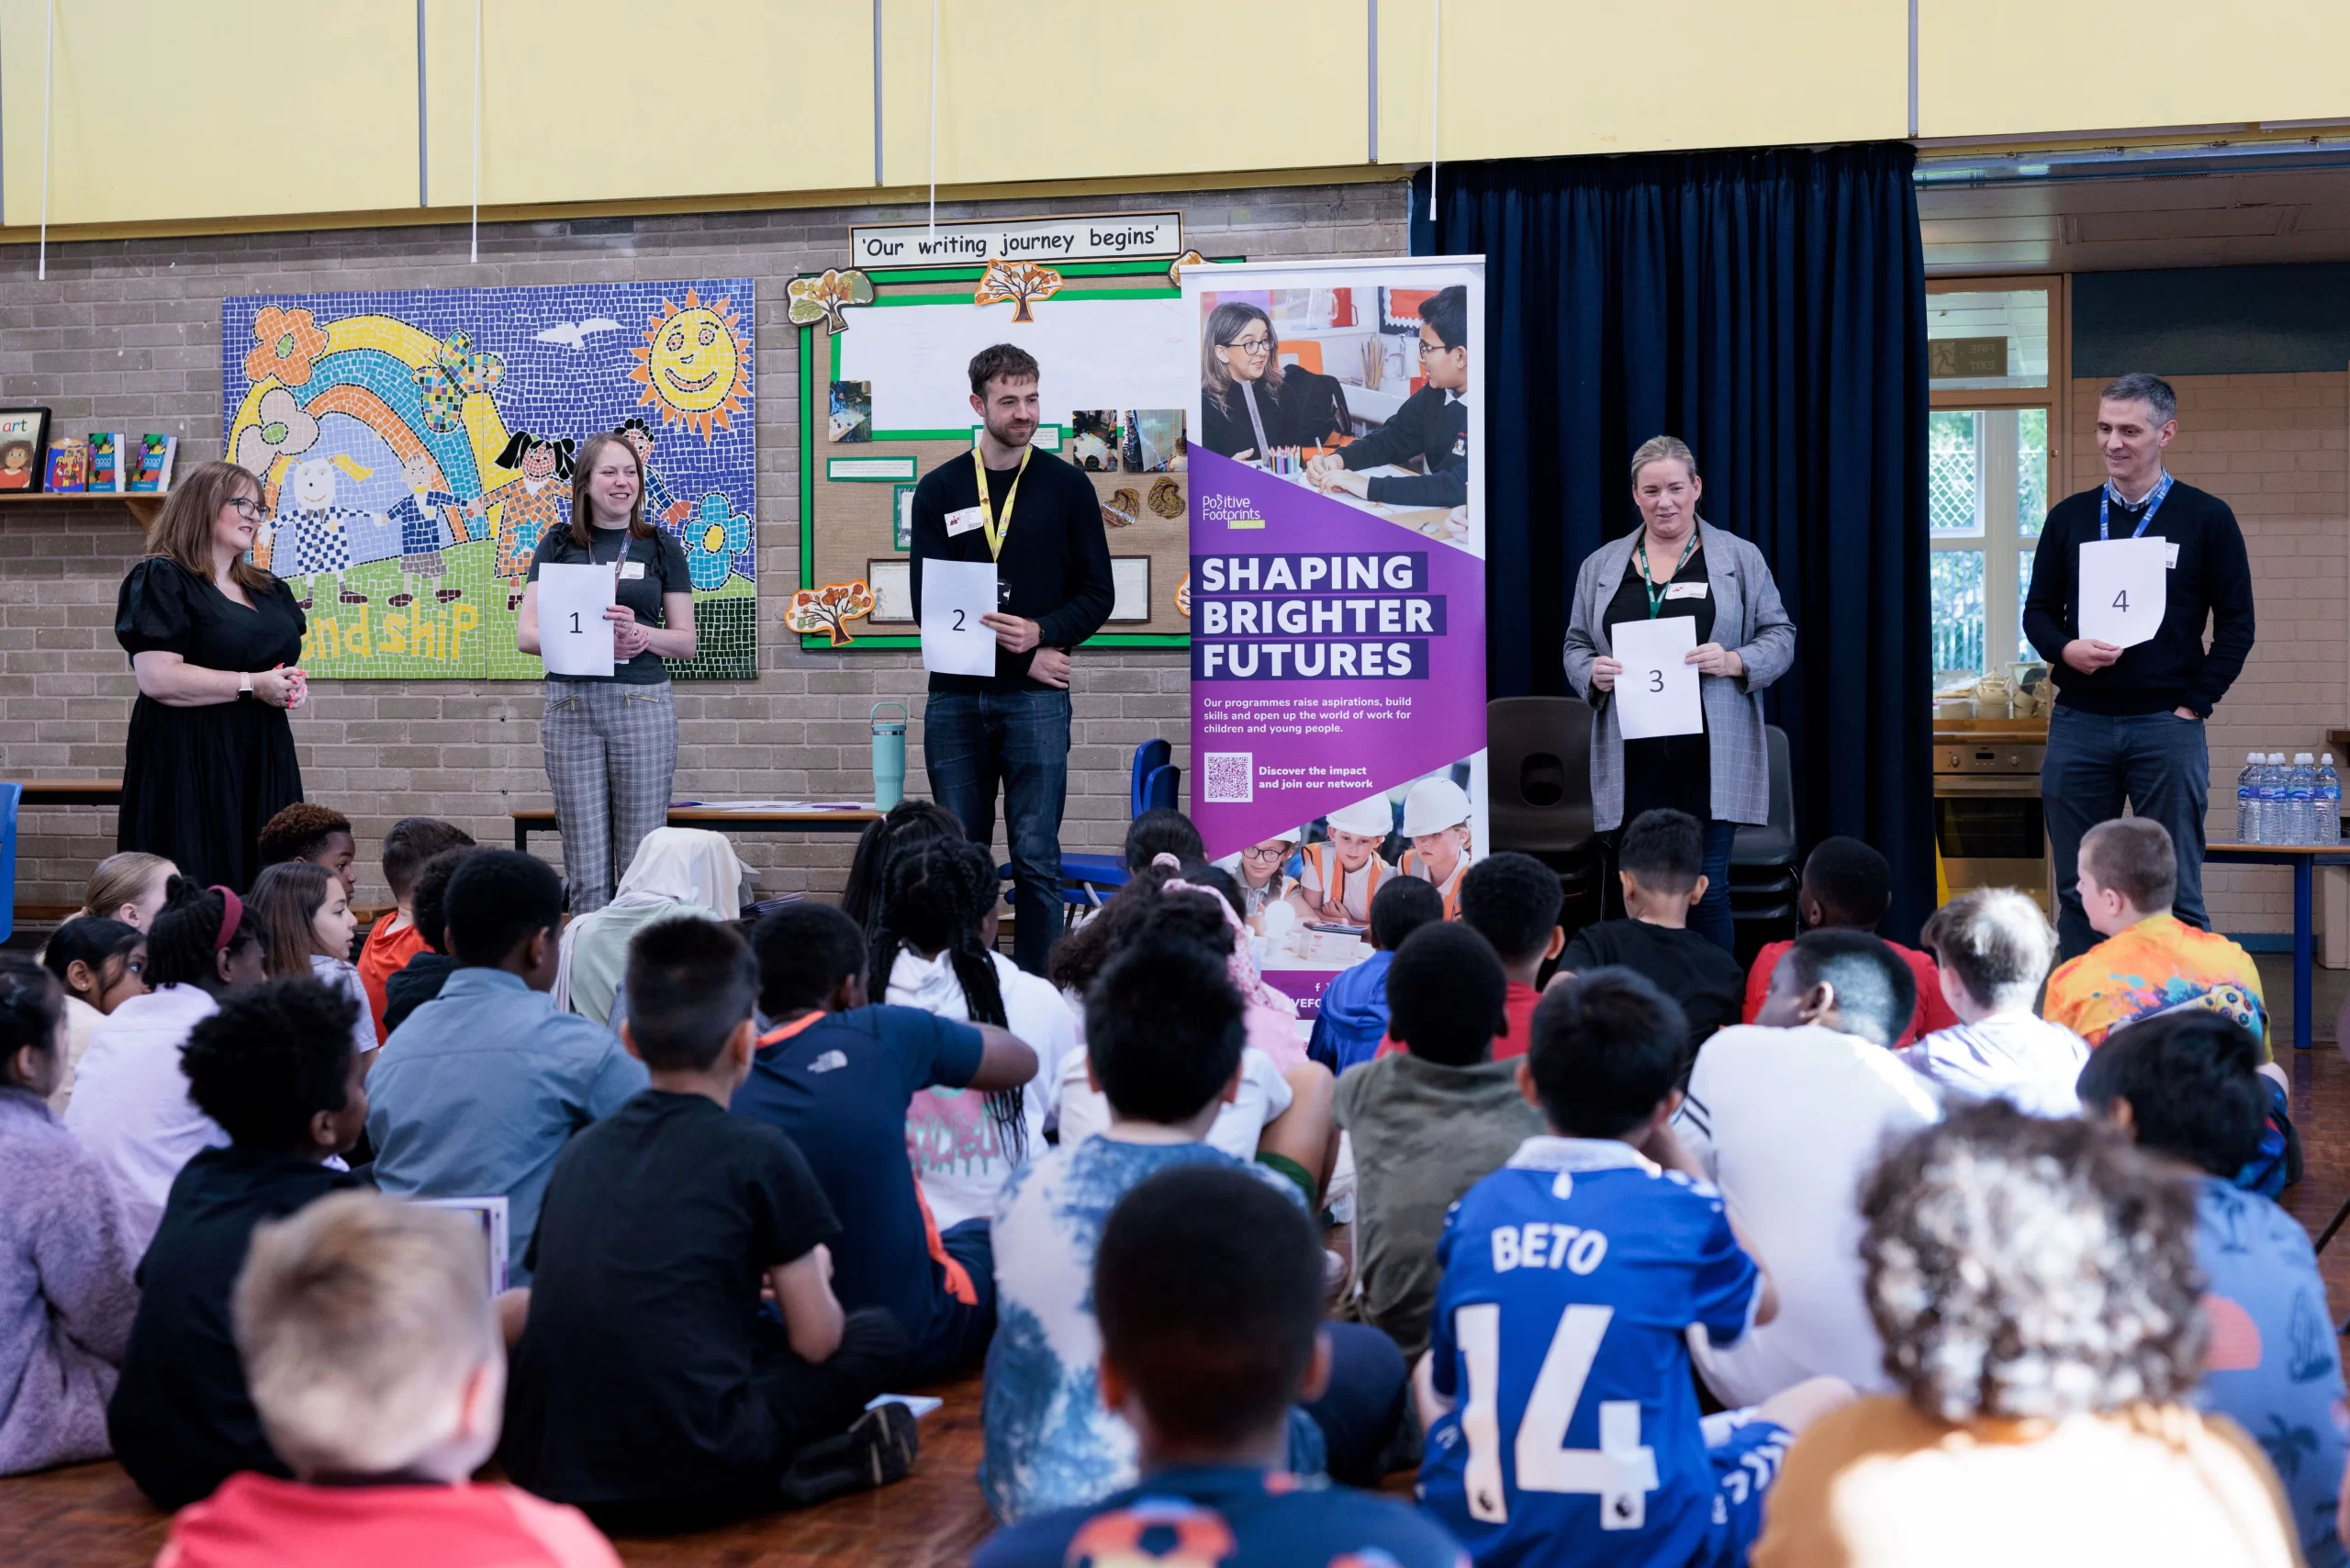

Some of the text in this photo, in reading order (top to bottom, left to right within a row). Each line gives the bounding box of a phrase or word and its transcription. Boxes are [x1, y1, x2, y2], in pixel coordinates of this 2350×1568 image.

[917, 235, 988, 258] writing
[999, 232, 1075, 257] journey
[2, 419, 28, 433] art
[1202, 493, 1251, 510] Positive
[1202, 507, 1261, 530] Footprints
[1202, 554, 1414, 592] SHAPING
[2111, 589, 2130, 612] 4
[569, 611, 583, 634] 1
[952, 609, 967, 632] 2
[1203, 599, 1435, 635] BRIGHTER
[1203, 642, 1413, 678] FUTURES
[1649, 669, 1664, 693] 3
[1203, 697, 1412, 711] Our programmes raise aspirations, build
[1203, 710, 1412, 723] skills and open up the world of work for
[1203, 723, 1344, 735] children and young people.
[1259, 766, 1368, 778] Discover the impact
[1259, 778, 1373, 791] and join our network
[1491, 1222, 1608, 1276] BETO
[1455, 1302, 1660, 1530] 14
